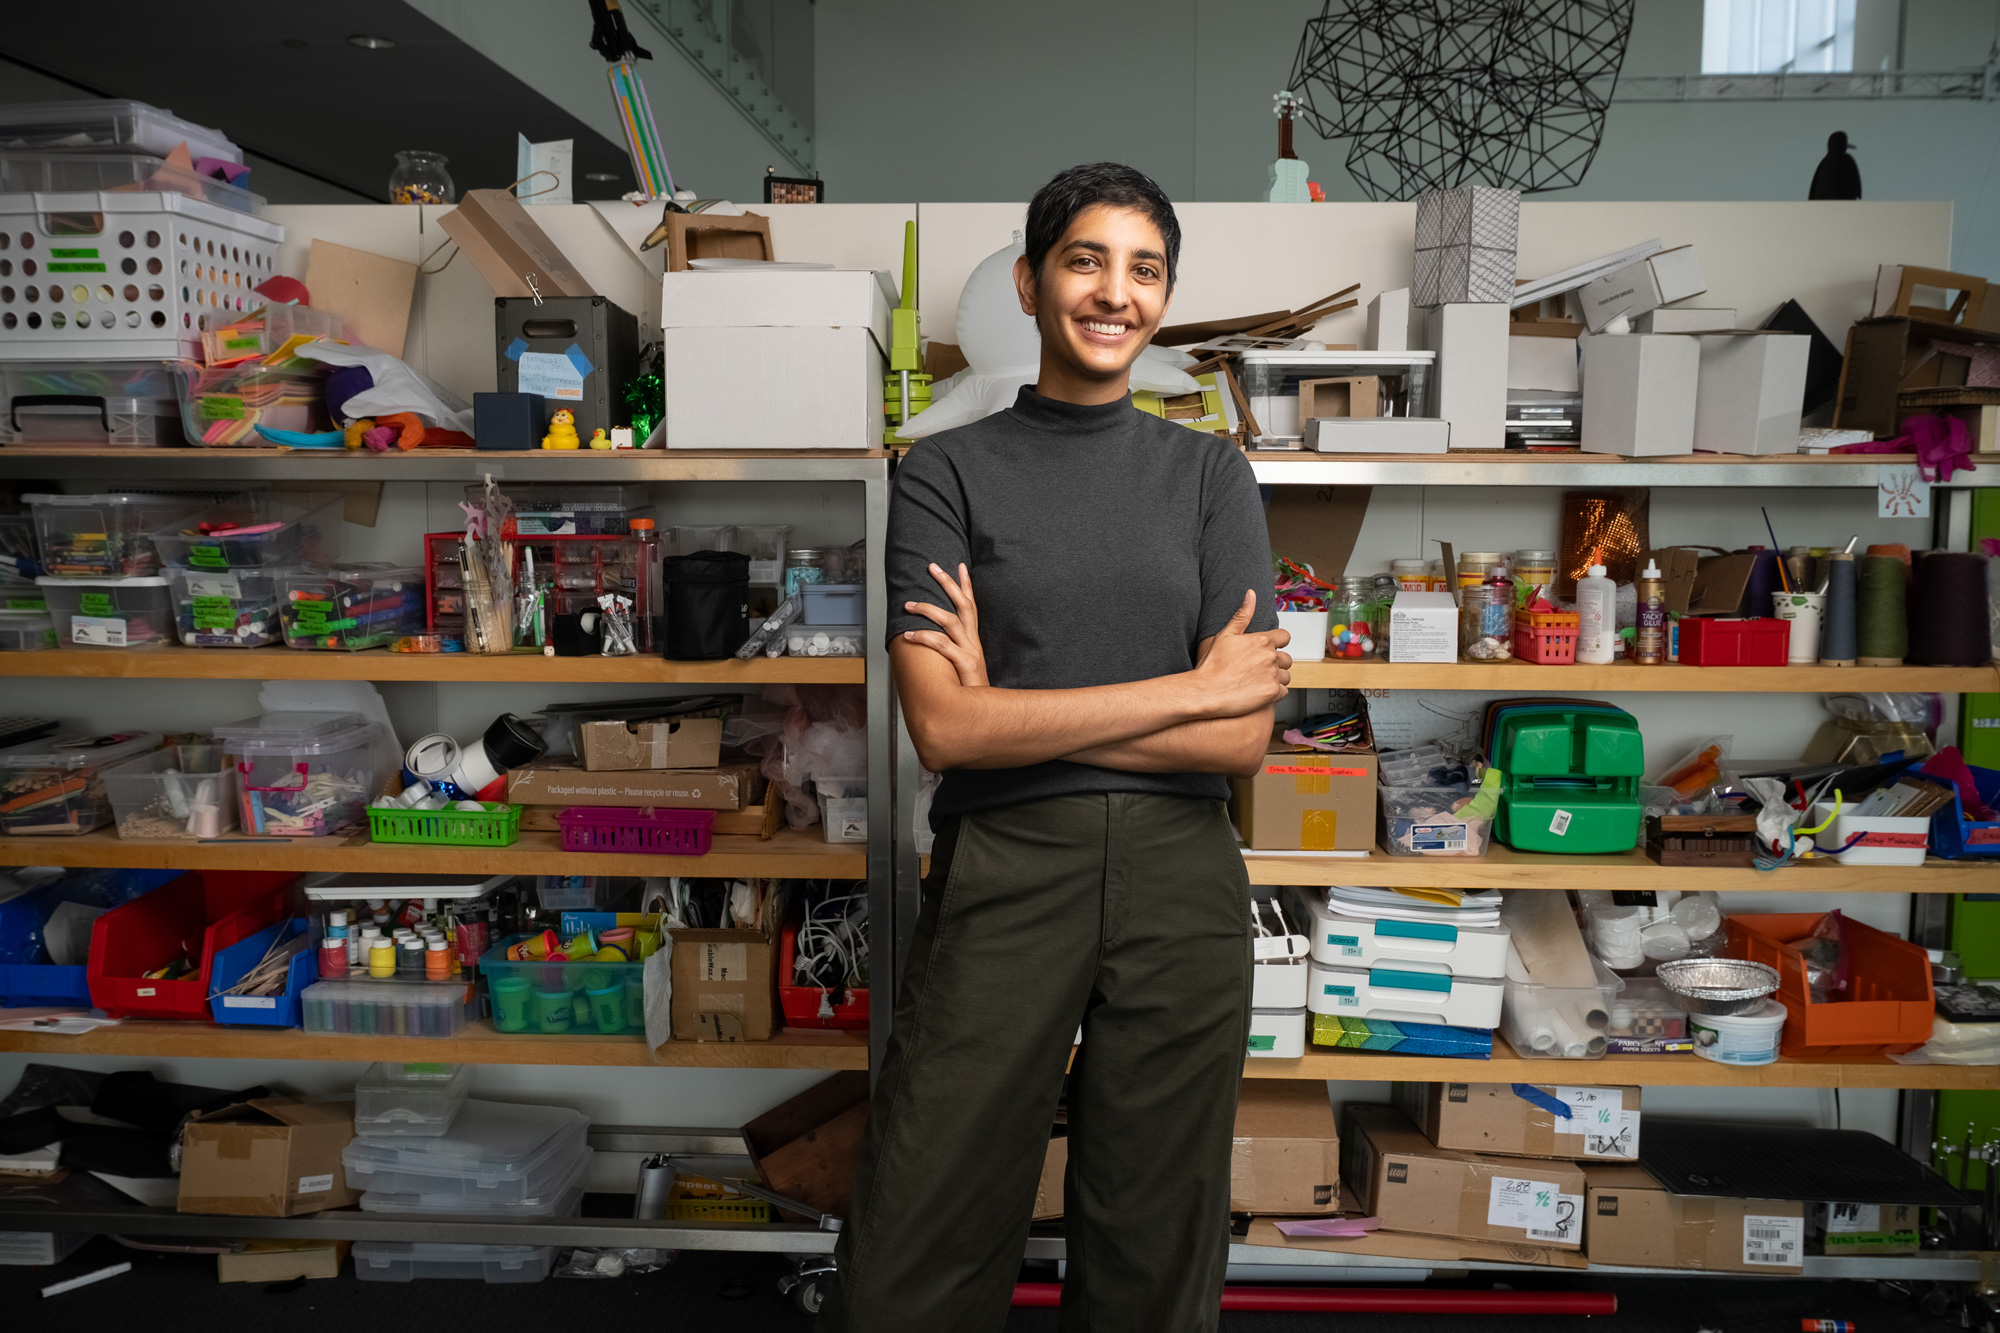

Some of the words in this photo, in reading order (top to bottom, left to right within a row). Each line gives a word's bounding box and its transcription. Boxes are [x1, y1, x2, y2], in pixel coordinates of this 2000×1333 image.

[1403, 583, 1422, 592] MOD
[1641, 612, 1664, 620] TACKY
[1643, 619, 1662, 627] GLUE
[1329, 767, 1354, 776] Supplies
[547, 785, 575, 795] Packaged
[575, 785, 597, 795] without
[598, 786, 617, 797] plastic
[624, 787, 643, 796] Please
[644, 788, 664, 798] recycle
[665, 789, 671, 797] or
[672, 789, 690, 798] reuse.
[1329, 936, 1357, 945] Science
[1326, 986, 1352, 994] Science
[1450, 1088, 1467, 1097] LEGO
[1390, 1169, 1406, 1177] LEGO
[1506, 1180, 1531, 1192] 2,88
[1599, 1202, 1617, 1210] LEGO
